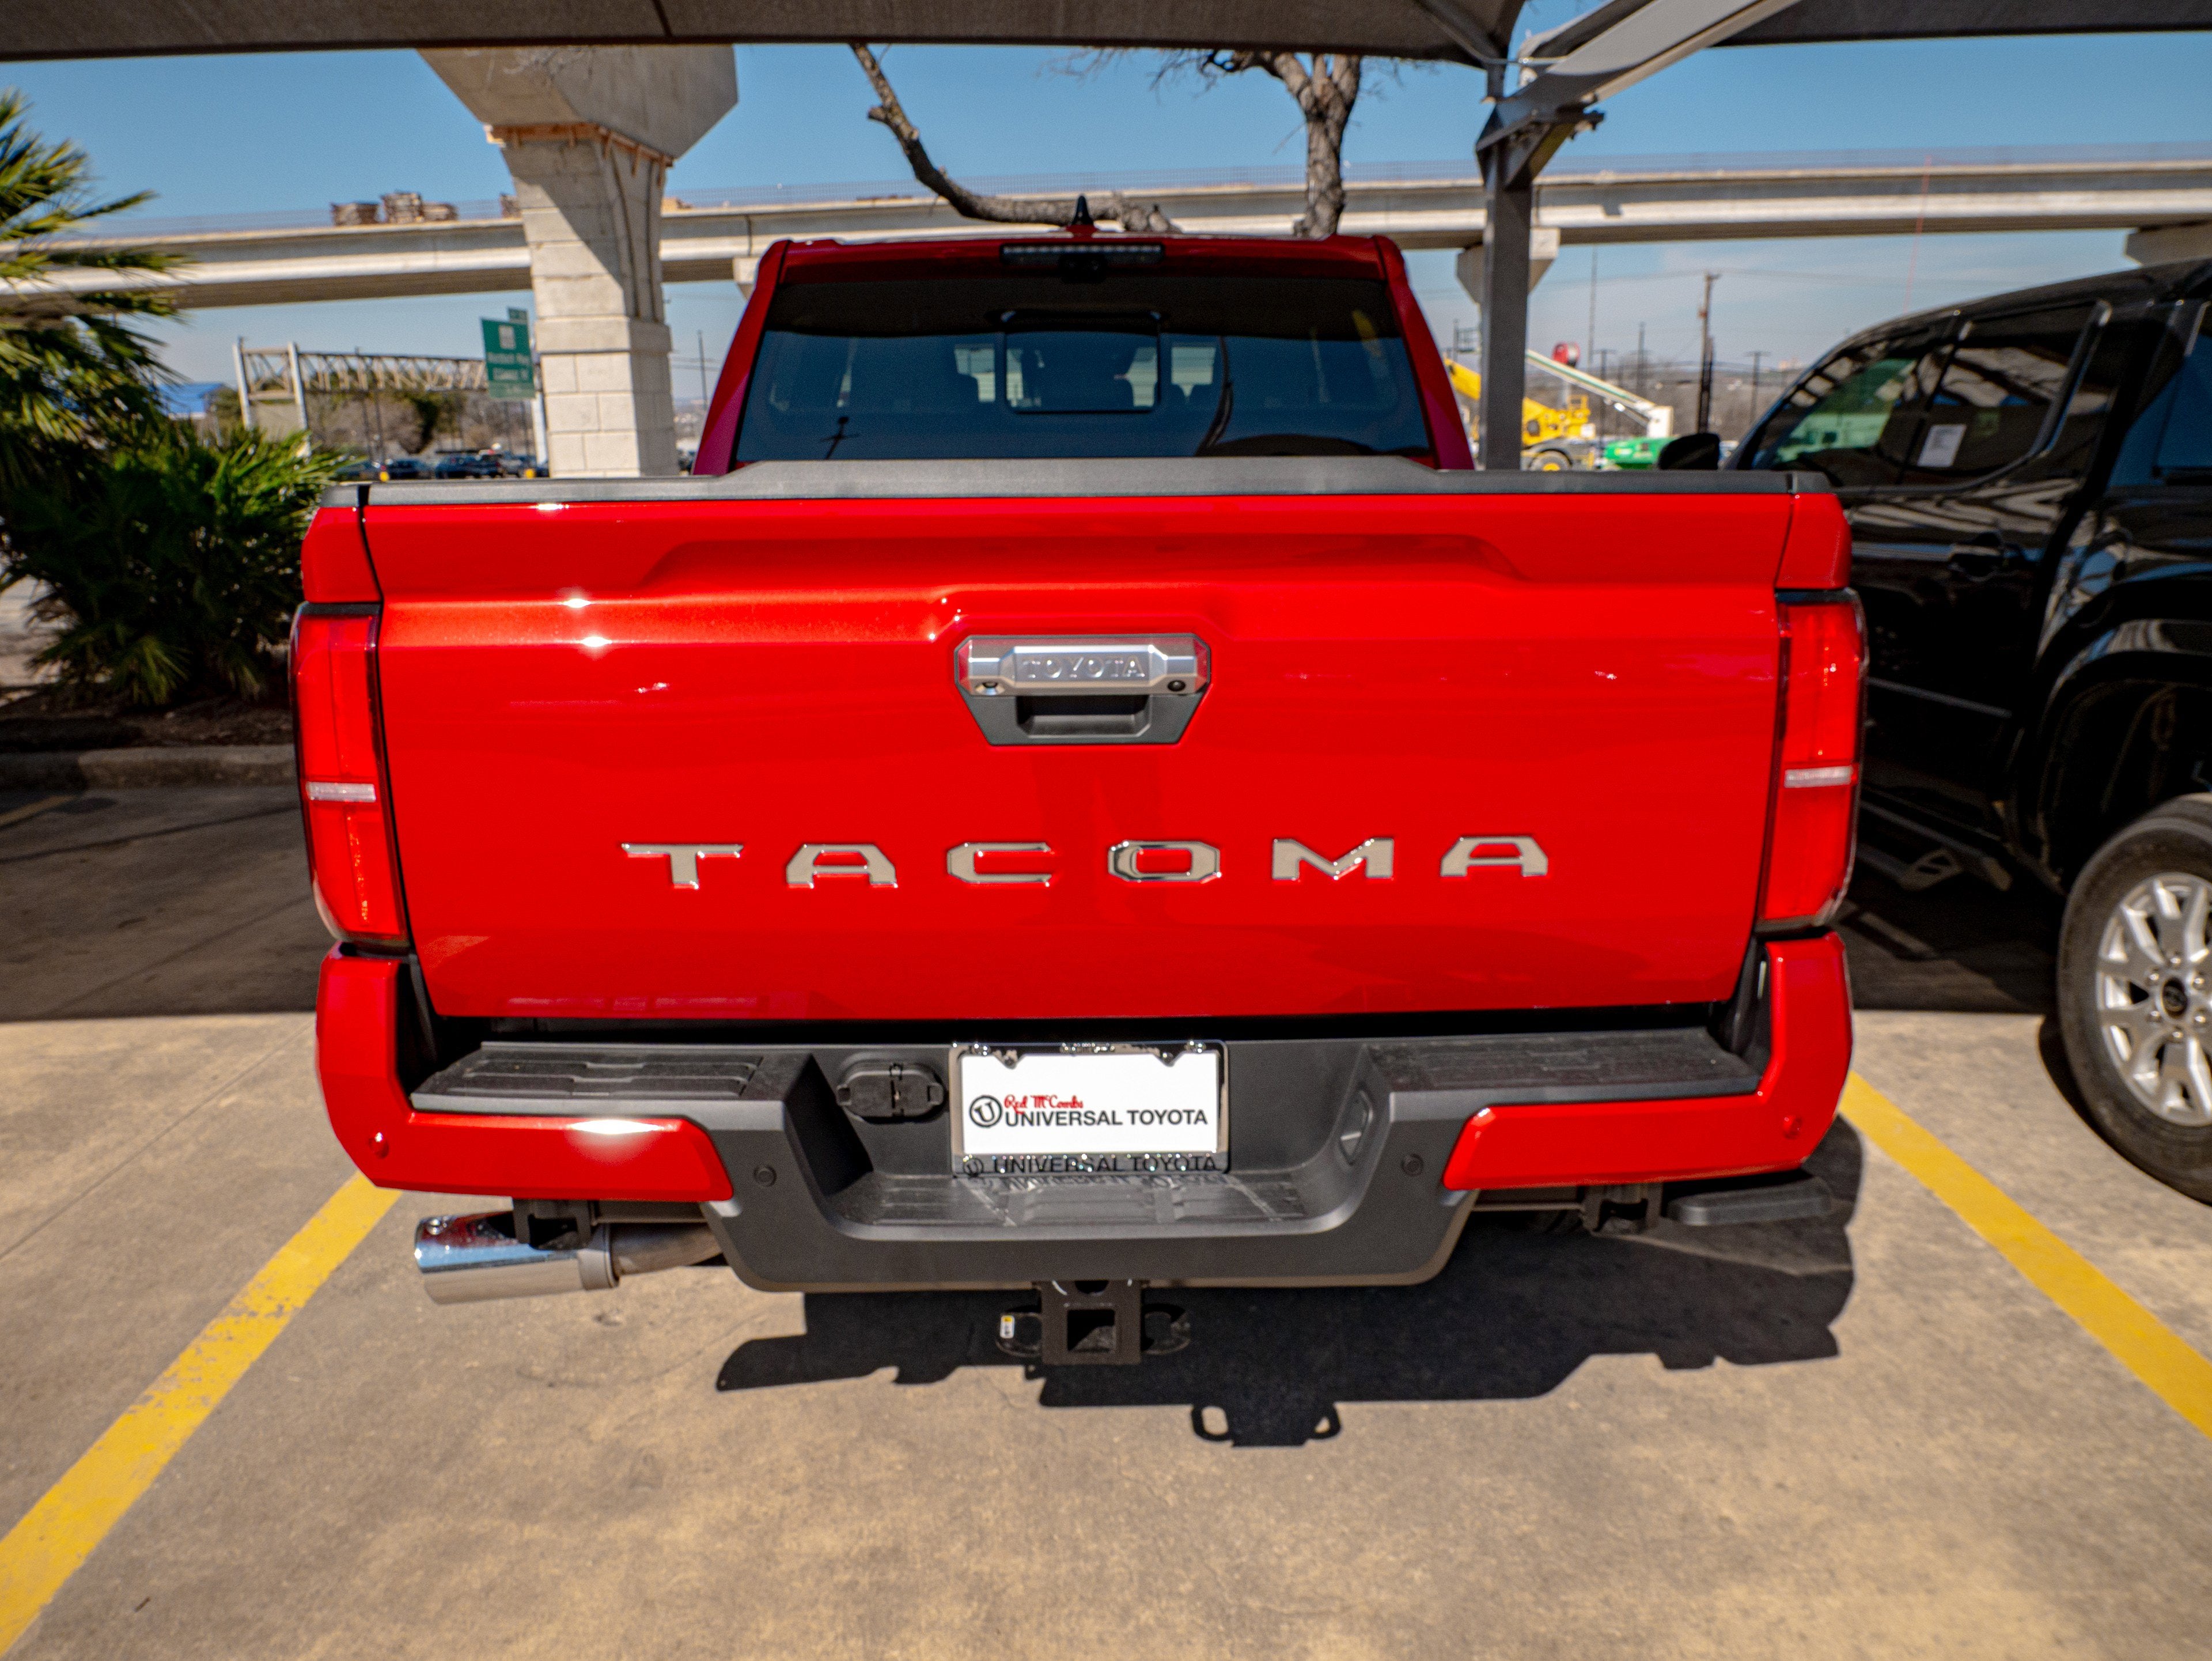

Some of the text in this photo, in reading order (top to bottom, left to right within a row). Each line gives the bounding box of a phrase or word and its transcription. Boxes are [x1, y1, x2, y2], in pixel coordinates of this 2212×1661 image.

[1022, 654, 1146, 679] TOYOTA
[622, 836, 1550, 891] TACOMA
[1004, 1094, 1084, 1115] Red McCombs
[1005, 1109, 1208, 1126] UNIVERSAL TOYOTA
[994, 1155, 1217, 1173] UNIVERSAL TOYOTA
